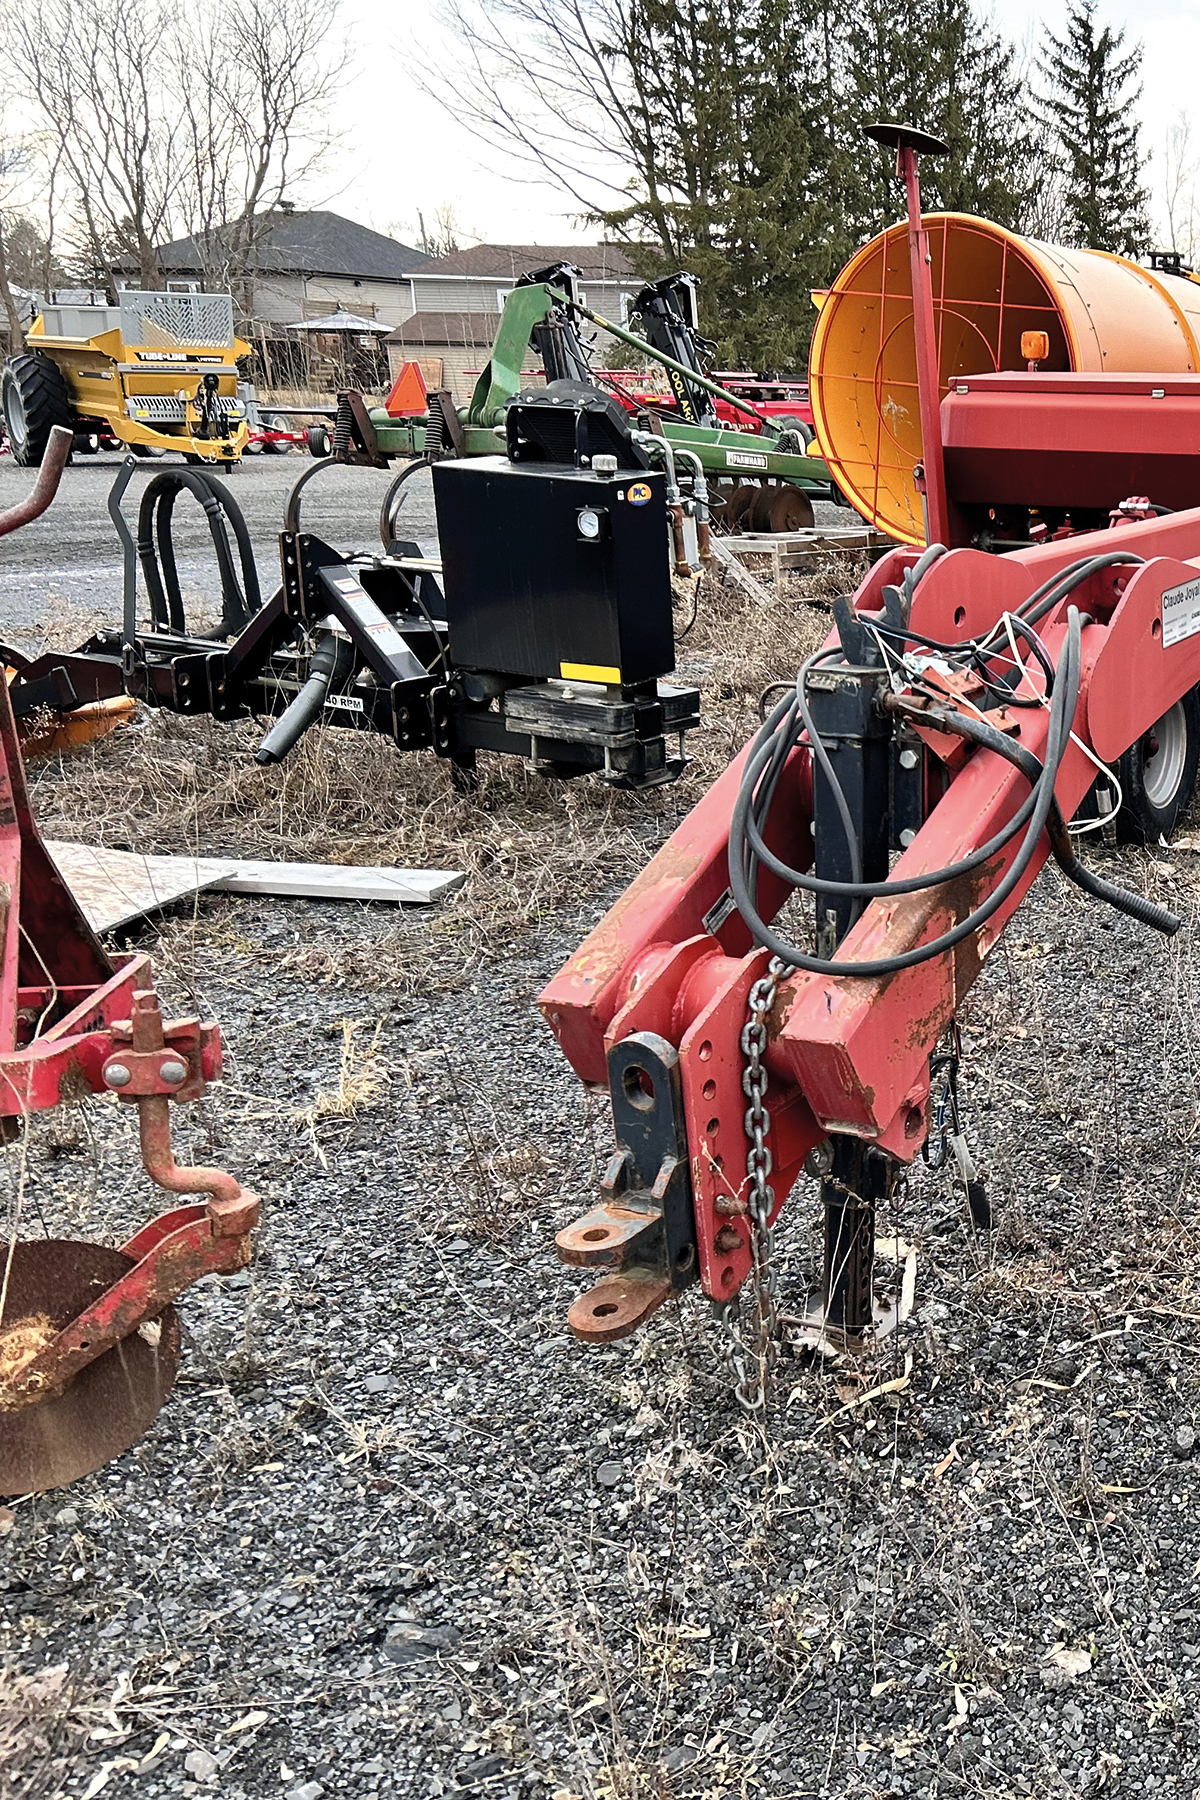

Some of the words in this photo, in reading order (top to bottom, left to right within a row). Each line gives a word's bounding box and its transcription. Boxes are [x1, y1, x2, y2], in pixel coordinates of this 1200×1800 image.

[1163, 590, 1184, 610] Claude
[1184, 582, 1200, 601] Joyal
[340, 698, 362, 709] RPM
